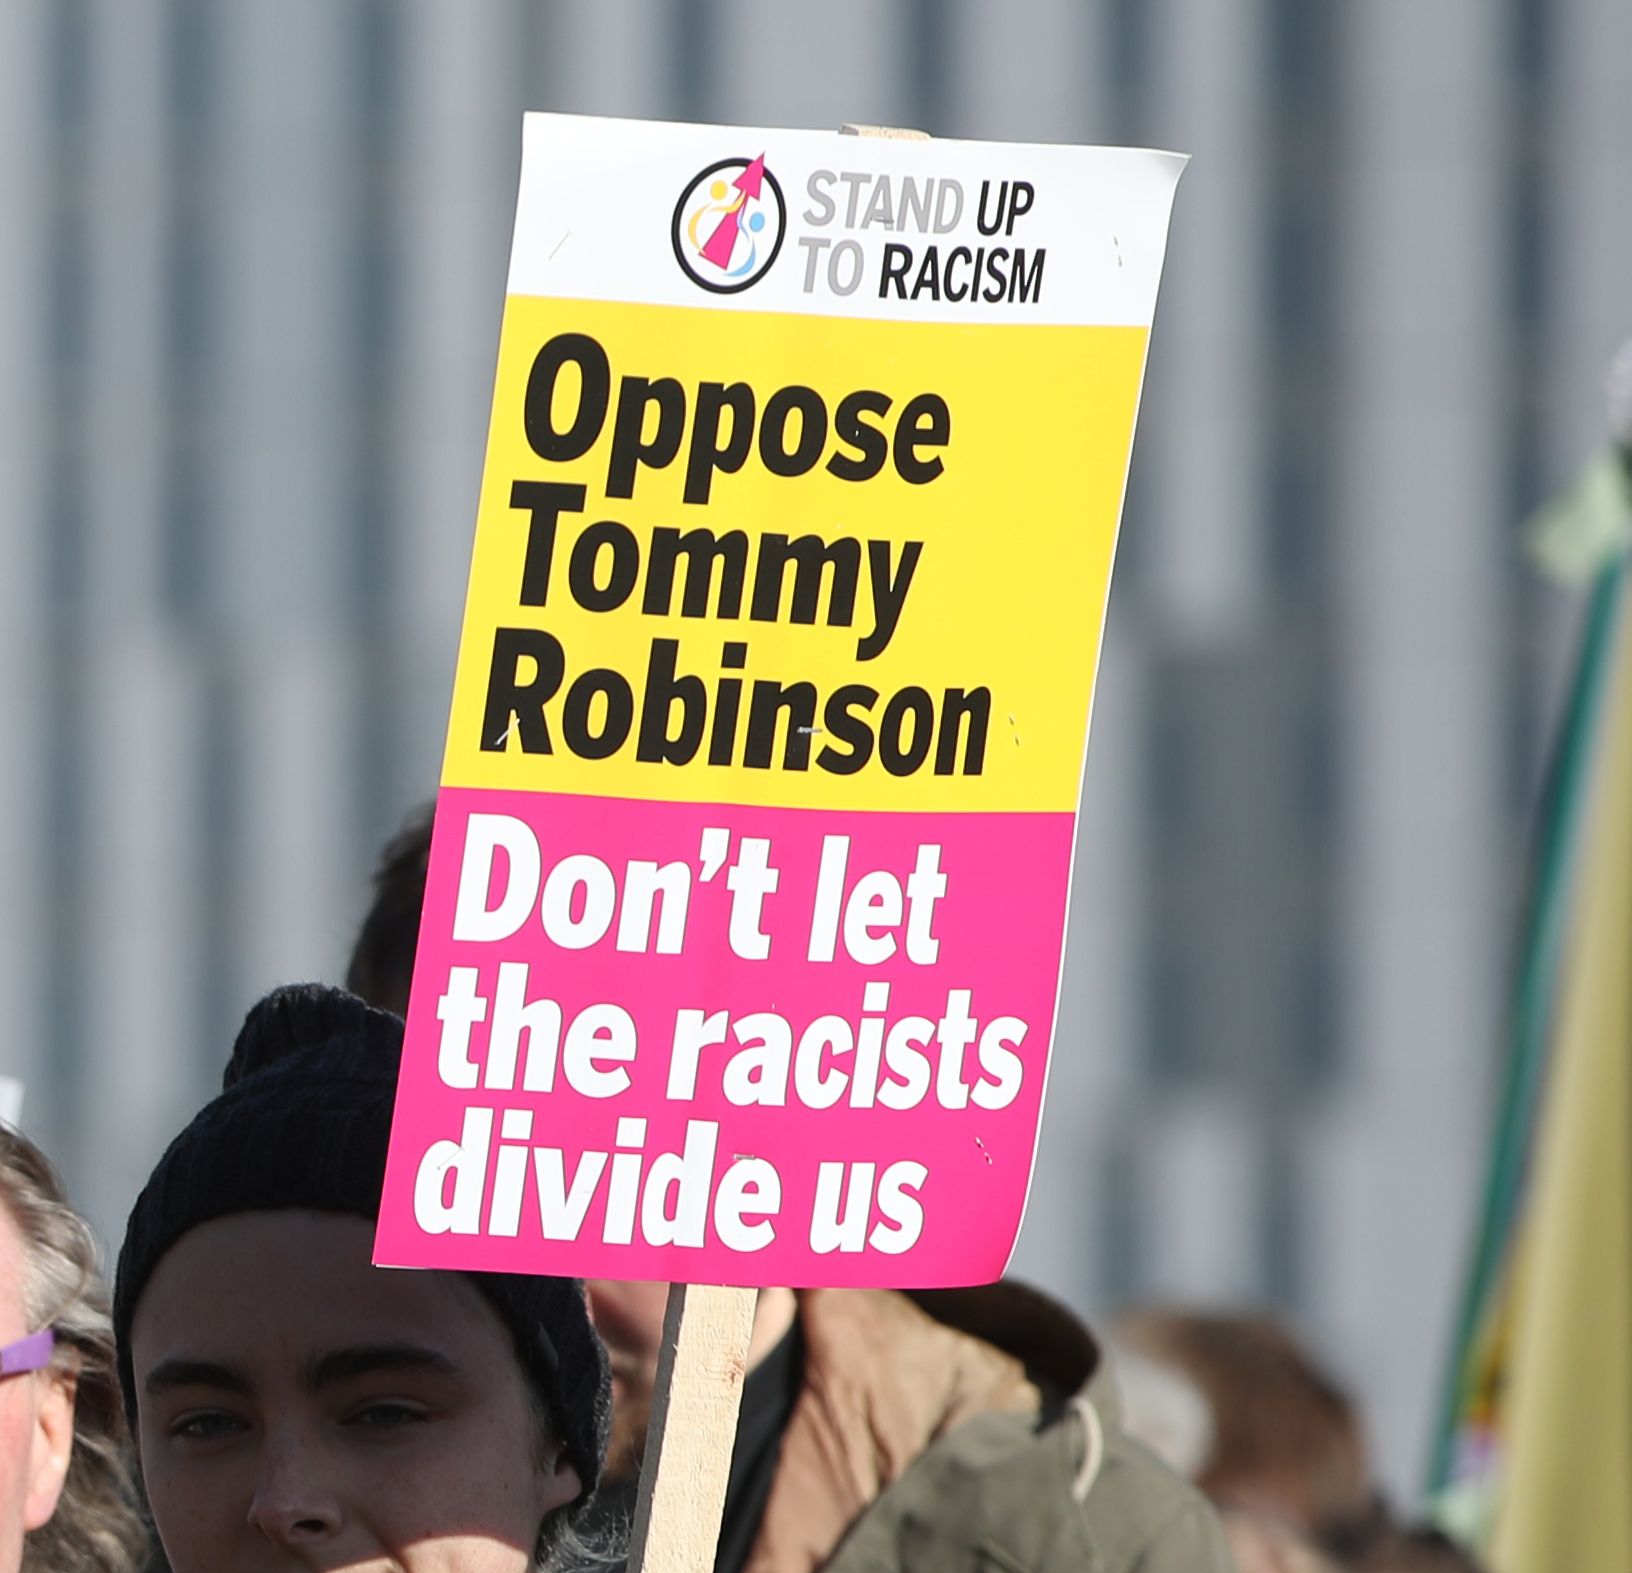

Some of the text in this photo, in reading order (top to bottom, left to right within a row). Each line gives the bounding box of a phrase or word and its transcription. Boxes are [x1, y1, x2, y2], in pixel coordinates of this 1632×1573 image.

[797, 236, 1046, 304] TO RACISM
[801, 169, 1035, 236] STAND UP
[523, 332, 951, 505] Oppose
[509, 480, 924, 662] Tommy
[480, 627, 992, 777] Robinson
[451, 813, 947, 965] Don't let
[436, 961, 1029, 1110] the racists
[413, 1106, 929, 1255] divide us
